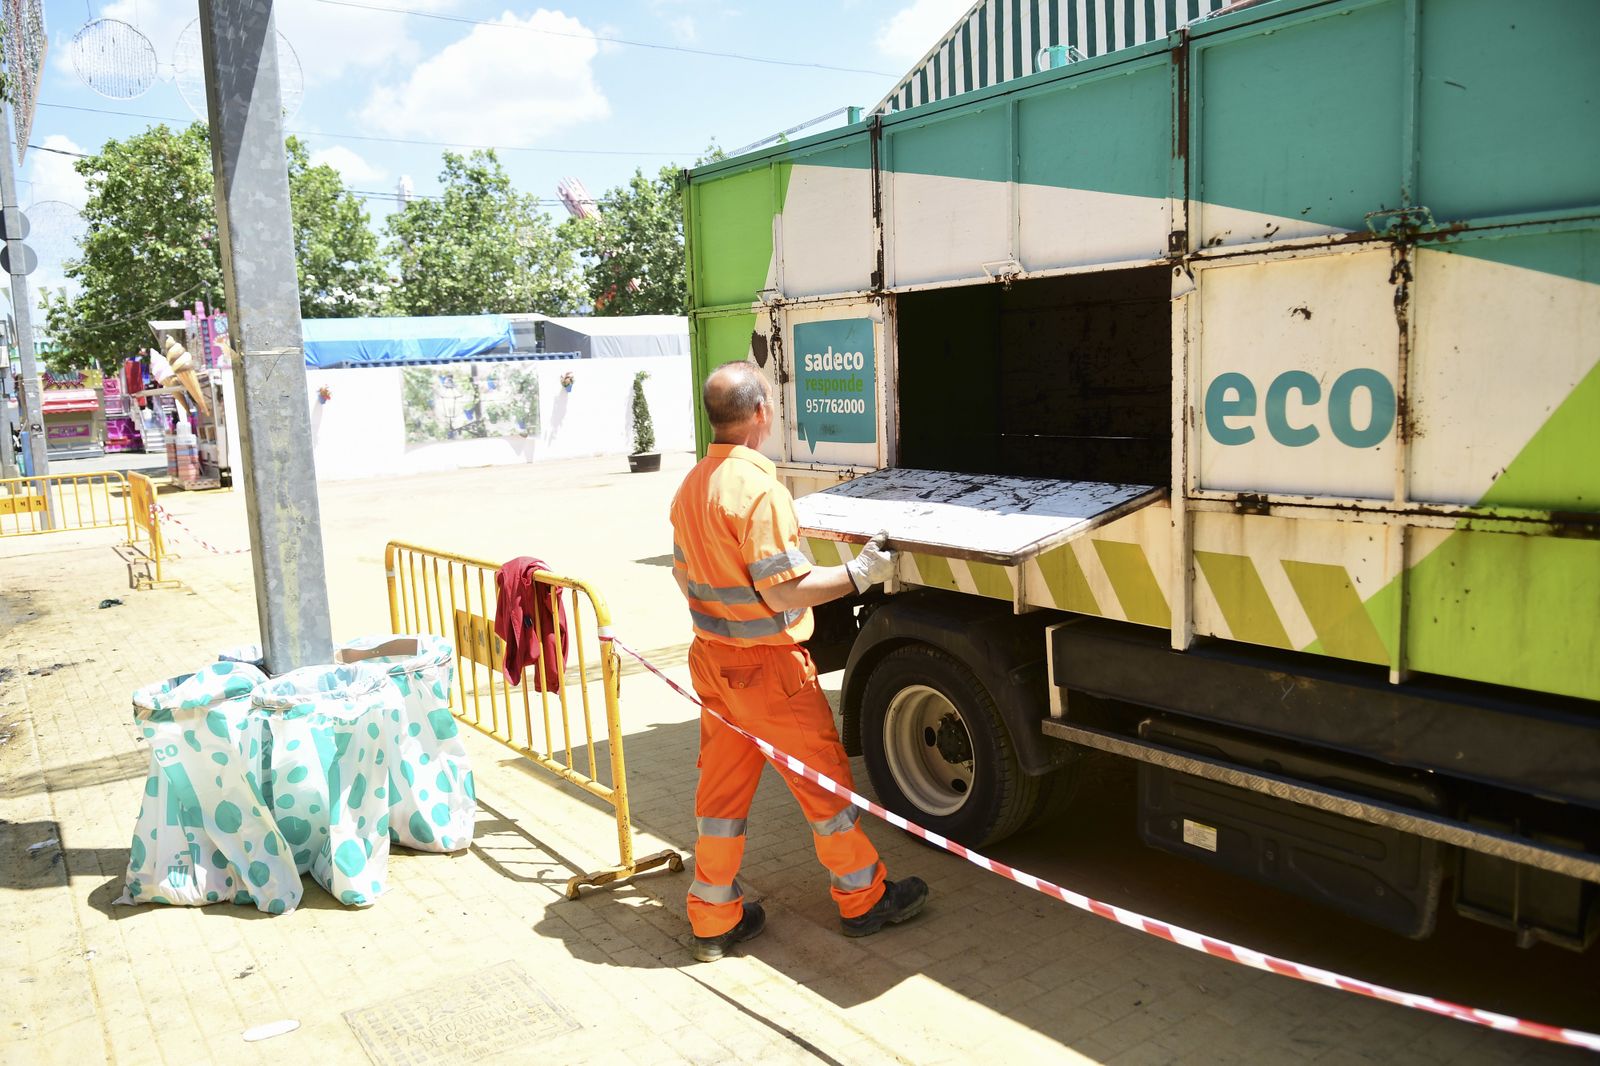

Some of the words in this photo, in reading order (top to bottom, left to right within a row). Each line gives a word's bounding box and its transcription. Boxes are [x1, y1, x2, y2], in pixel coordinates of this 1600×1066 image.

[804, 345, 864, 372] sadeco
[805, 373, 864, 397] responde
[806, 398, 865, 414] 957762000
[1204, 367, 1397, 449] eco
[420, 1035, 441, 1052] DE
